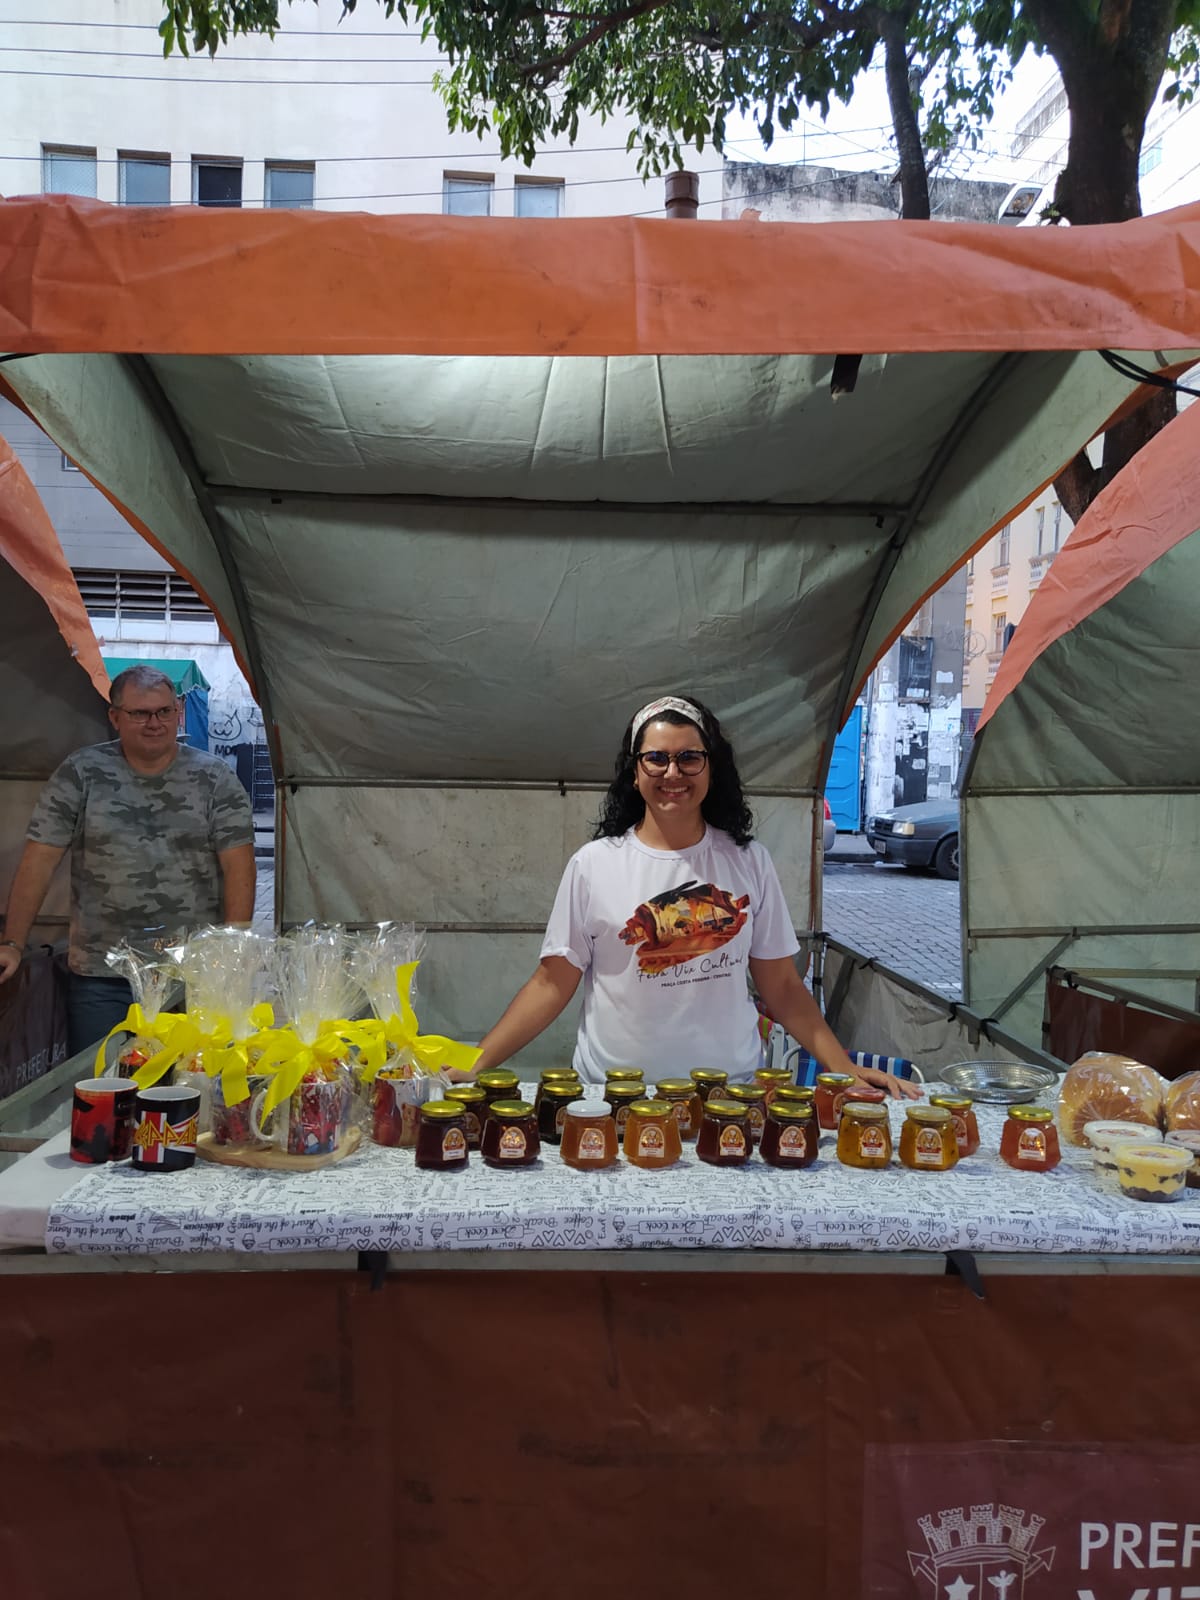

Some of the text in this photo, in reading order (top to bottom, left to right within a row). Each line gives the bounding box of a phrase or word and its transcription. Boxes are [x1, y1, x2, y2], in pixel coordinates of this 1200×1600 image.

[672, 964, 696, 978] Vix
[523, 1213, 593, 1227] Coffee Break
[703, 1213, 737, 1224] Break
[741, 1209, 770, 1224] Coffee
[237, 1222, 262, 1232] home
[264, 1222, 277, 1232] the
[338, 1221, 410, 1236] Coffee Break
[645, 1222, 668, 1232] Cook
[879, 1216, 946, 1232] Coffee Break
[147, 1233, 221, 1247] Coffee Break
[1090, 1236, 1118, 1249] Coffee
